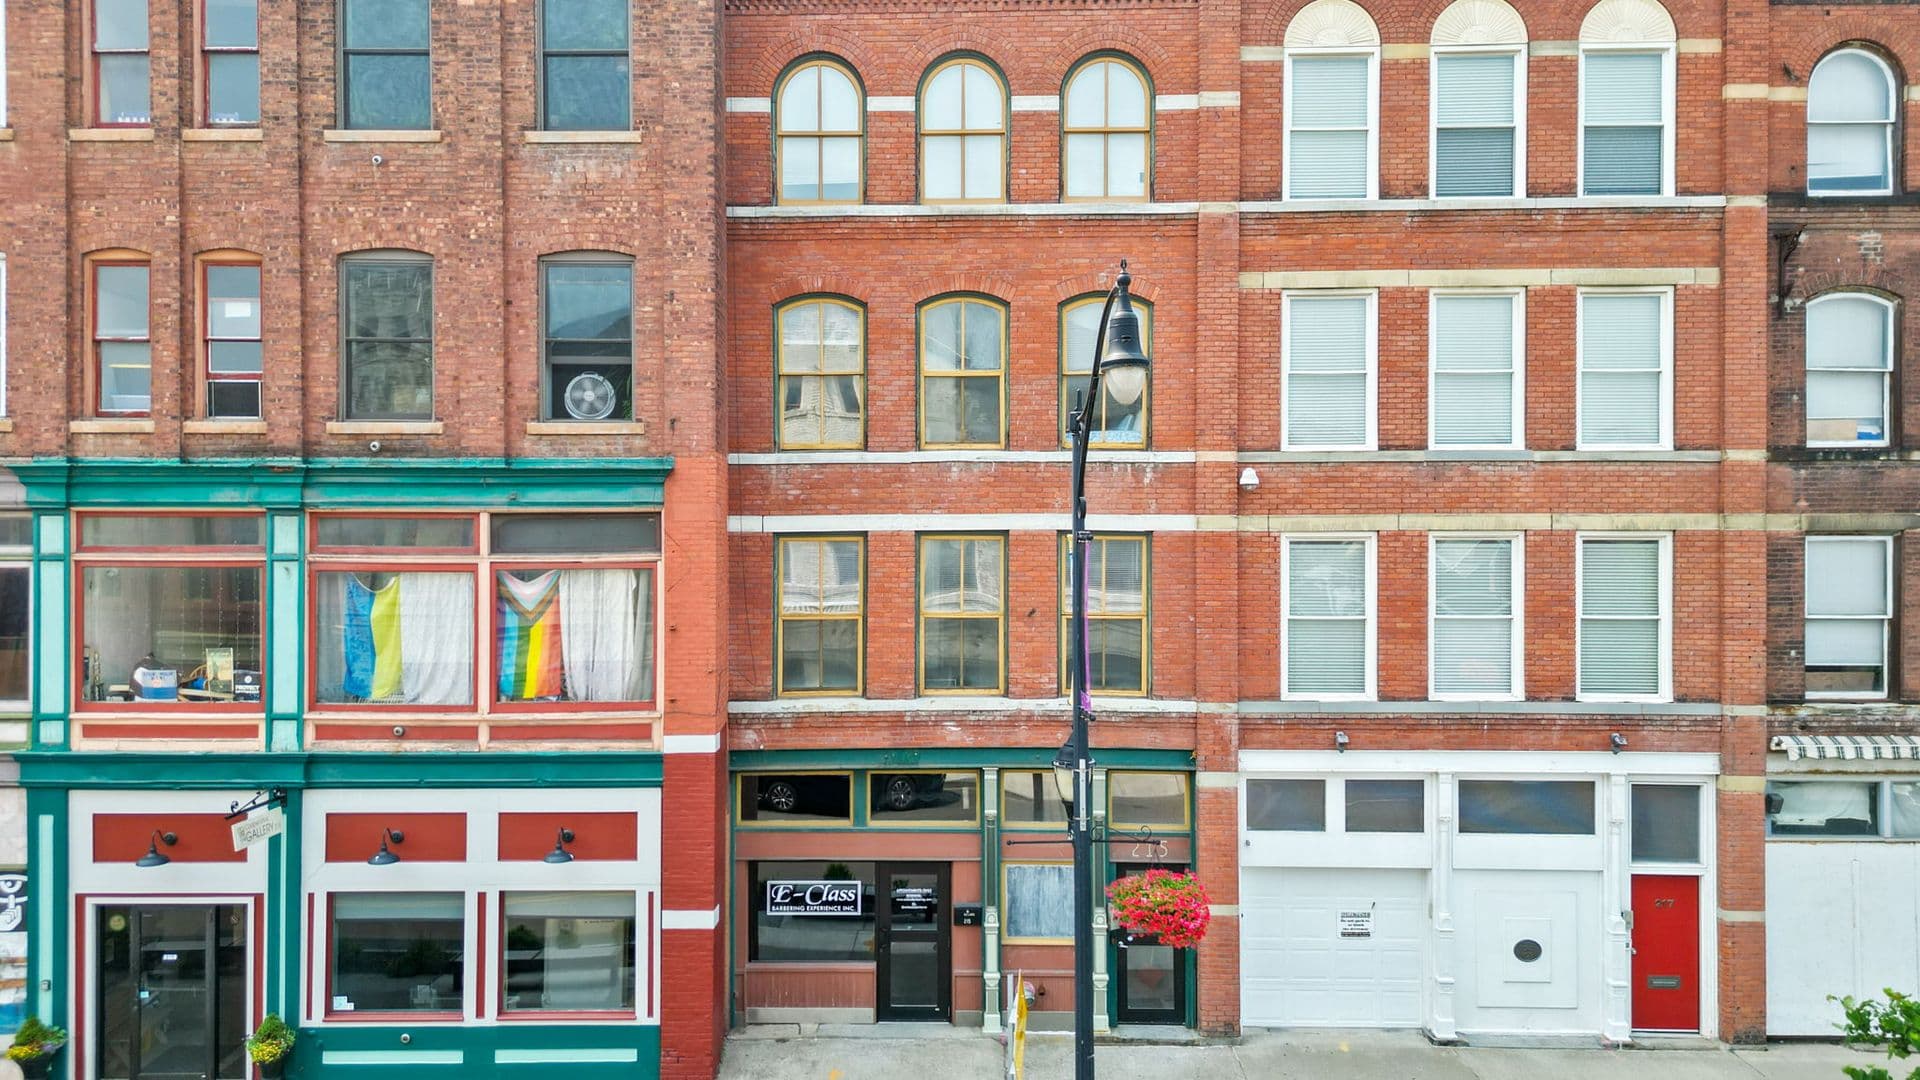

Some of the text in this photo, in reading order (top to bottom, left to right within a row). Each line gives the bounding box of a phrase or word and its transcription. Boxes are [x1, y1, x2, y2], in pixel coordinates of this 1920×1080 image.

[246, 820, 274, 842] GALLERY
[1131, 840, 1168, 857] 215
[771, 884, 856, 905] E-Class
